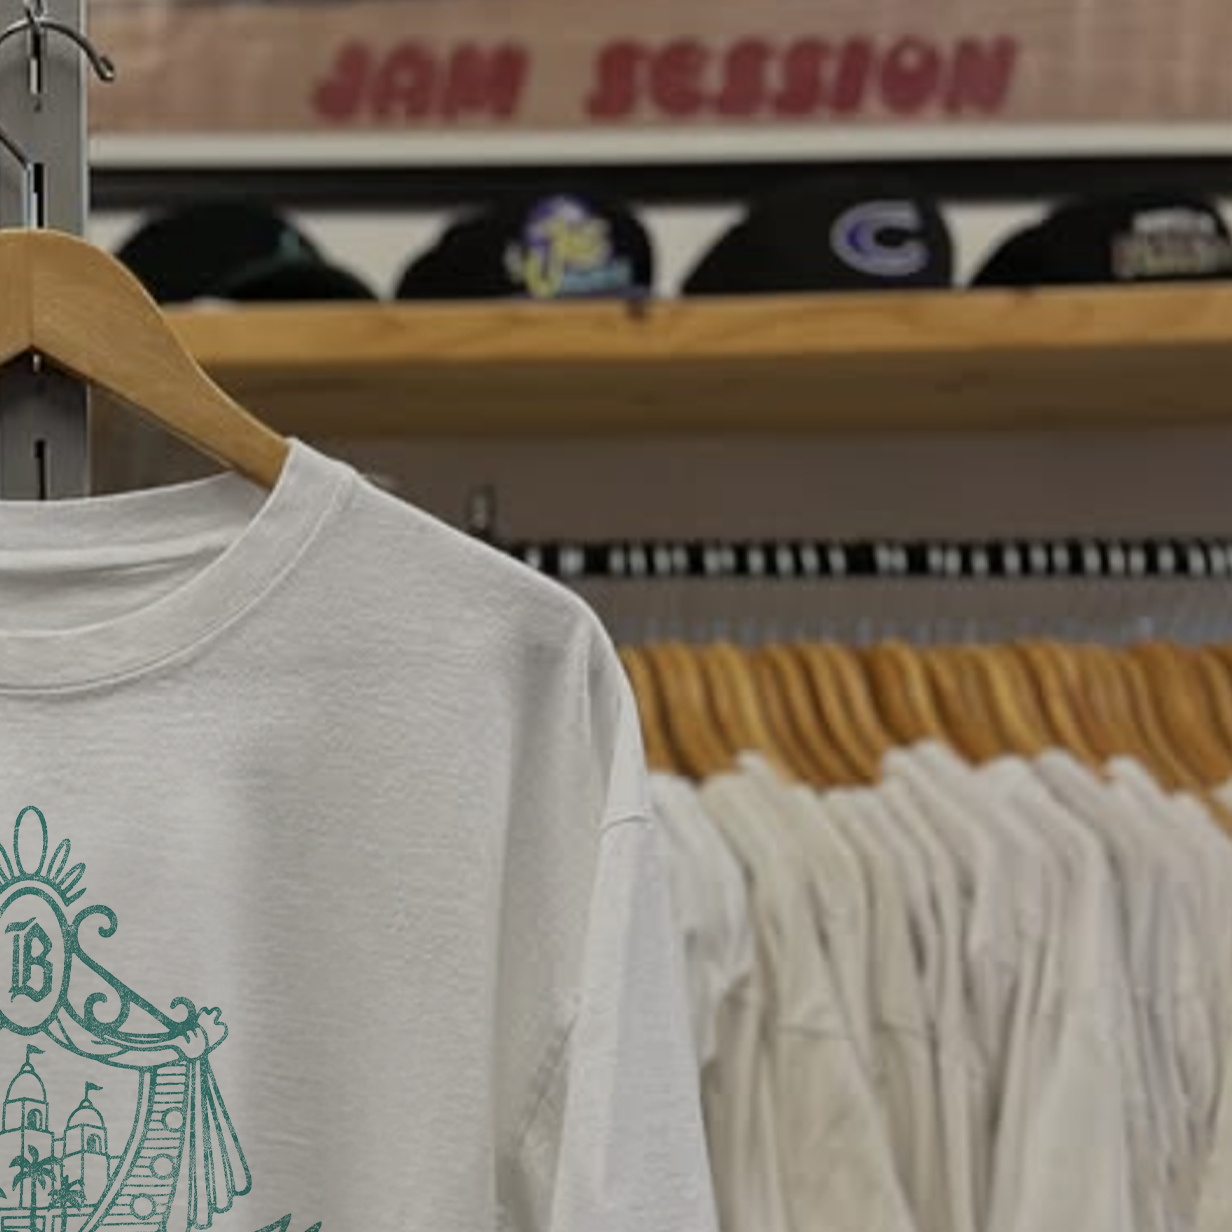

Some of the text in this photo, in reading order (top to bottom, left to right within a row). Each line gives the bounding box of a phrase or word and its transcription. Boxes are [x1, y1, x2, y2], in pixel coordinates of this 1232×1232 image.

[314, 36, 1018, 122] JAM SESSION
[4, 916, 53, 1003] B
